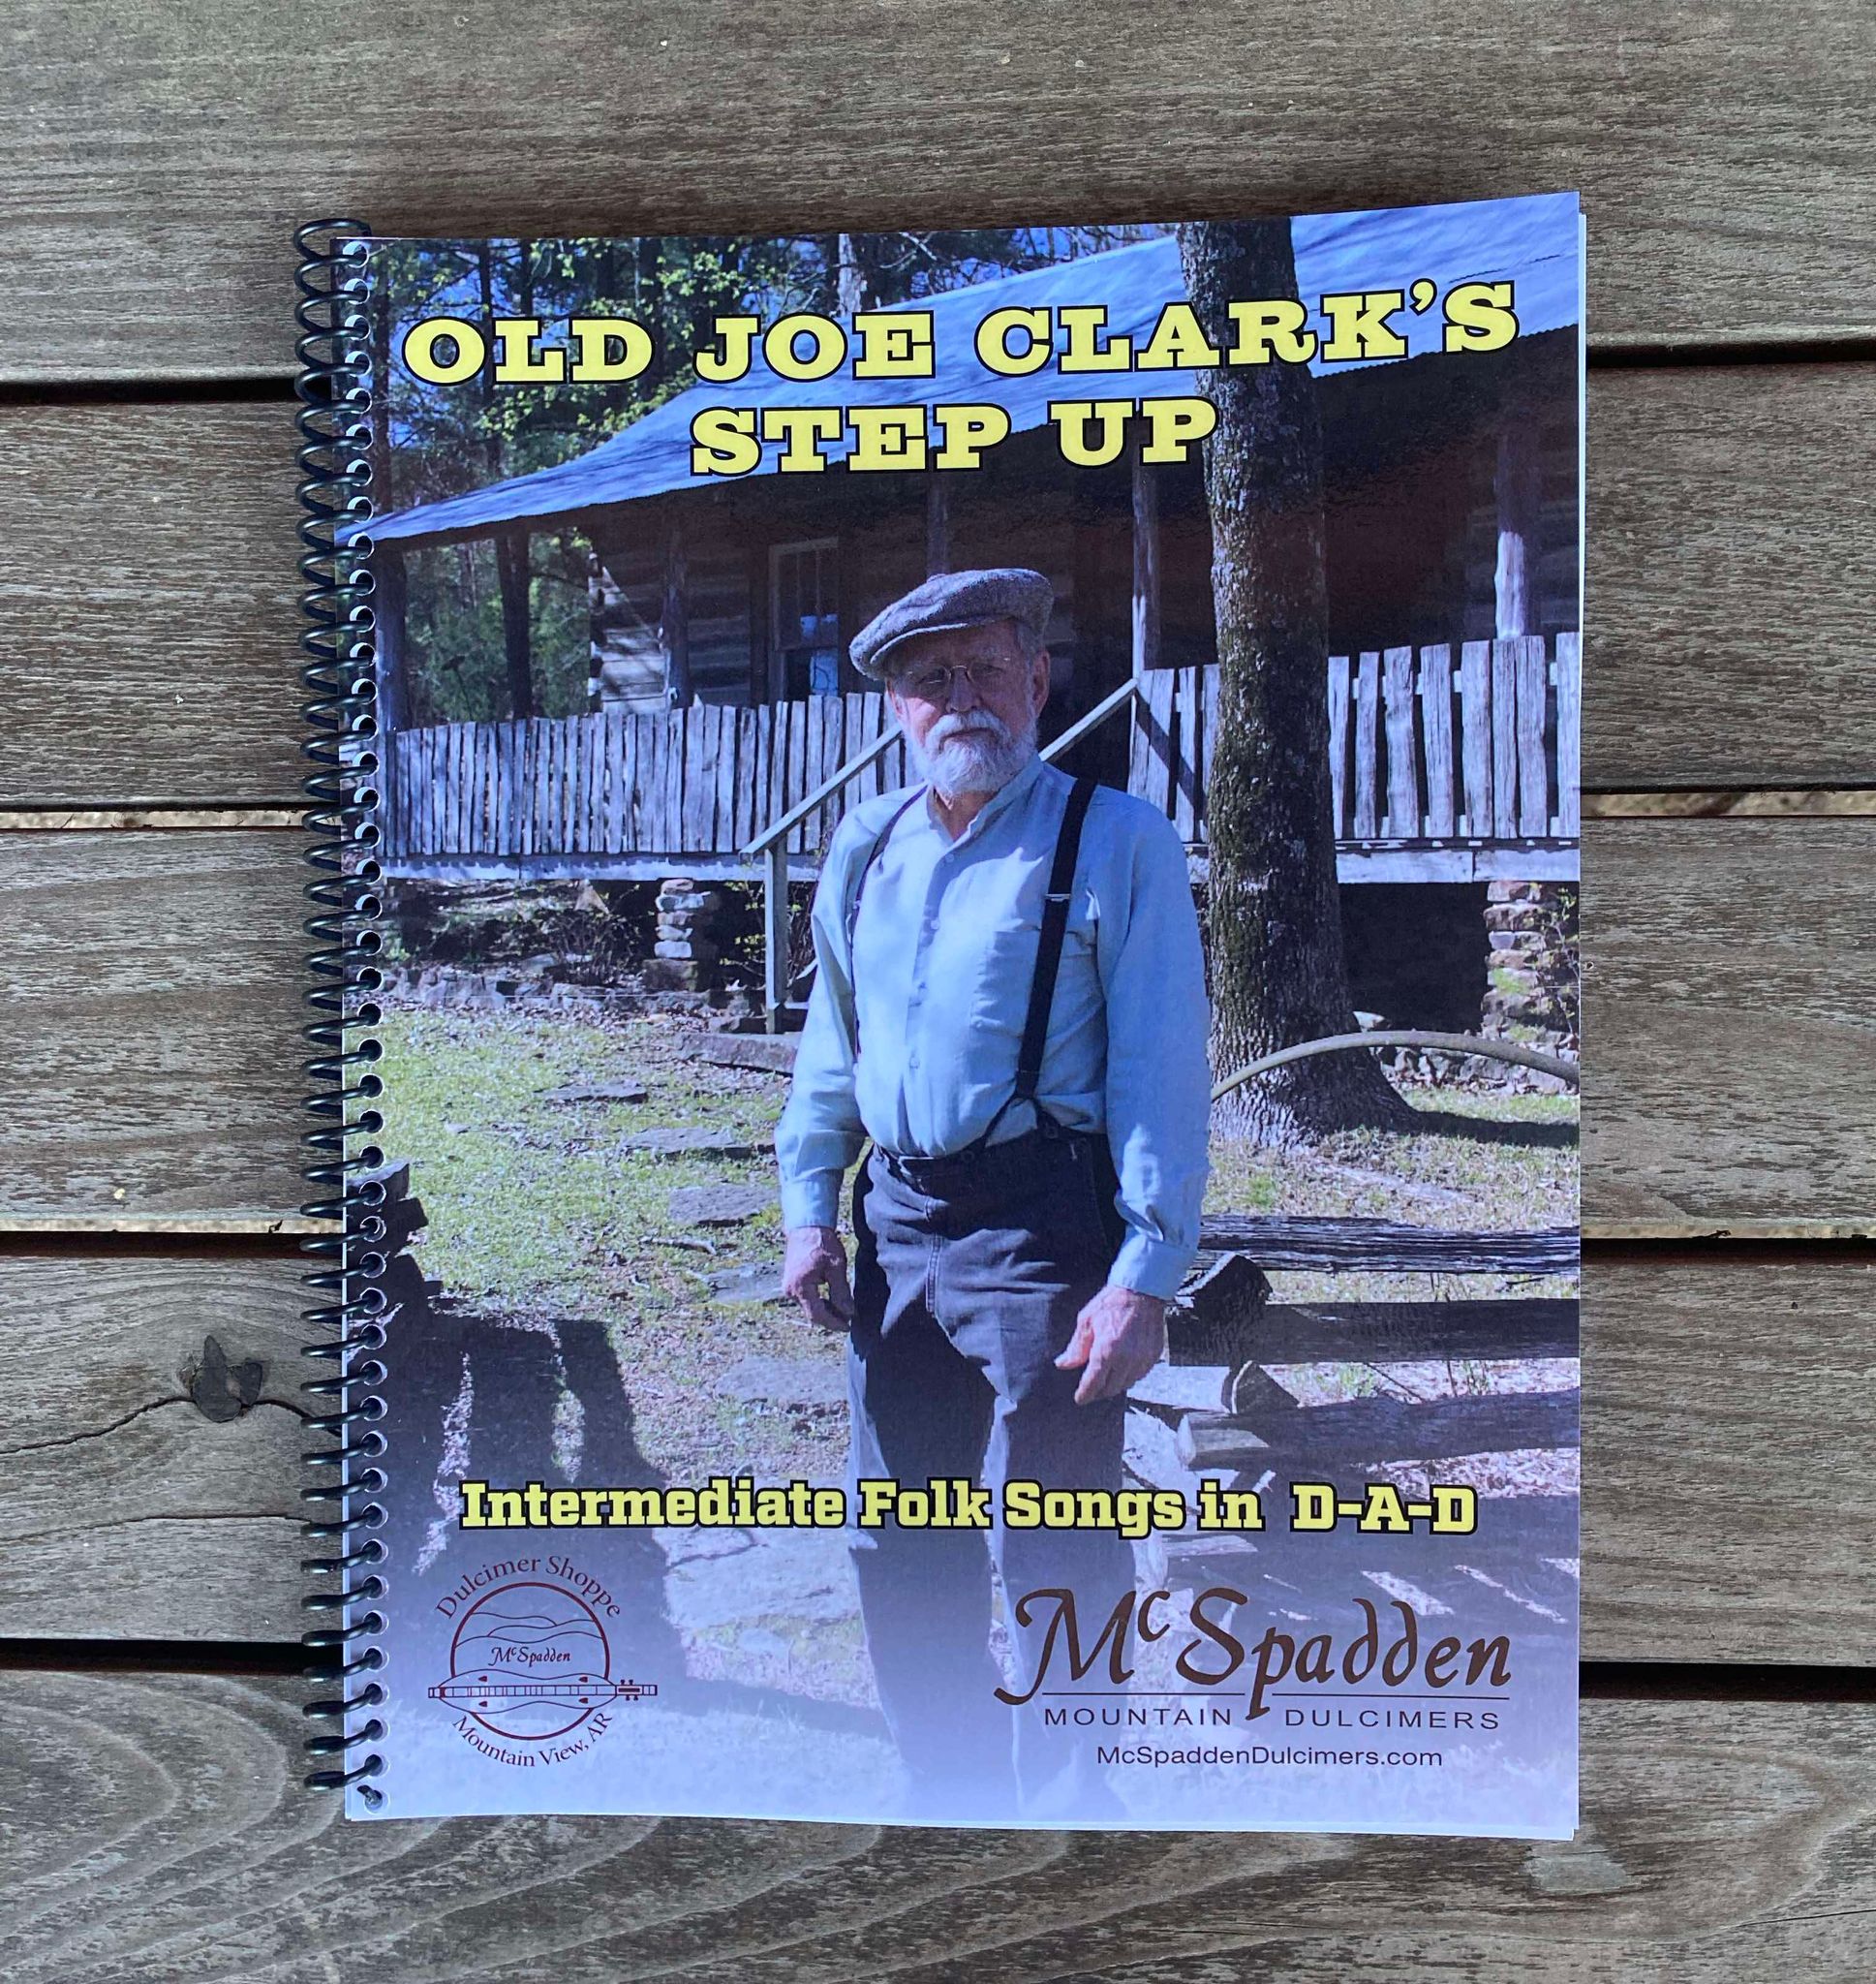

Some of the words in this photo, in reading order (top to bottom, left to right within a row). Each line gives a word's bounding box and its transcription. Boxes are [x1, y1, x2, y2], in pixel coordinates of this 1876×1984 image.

[402, 314, 655, 387] OLD
[692, 310, 936, 384] JOE
[974, 278, 1520, 378] CLARK’S
[690, 403, 1012, 477] STEP
[1047, 395, 1218, 470] UP
[459, 1477, 846, 1530] Intermediate
[857, 1477, 993, 1529] Folk
[1002, 1479, 1186, 1539] Songs
[1196, 1478, 1265, 1532] in
[1290, 1481, 1479, 1535] D-A-D
[436, 1558, 540, 1619] Dulcimer
[545, 1555, 620, 1618] Shoppe
[488, 1647, 570, 1667] McSpadden
[994, 1588, 1512, 1721] McSpadden
[452, 1716, 536, 1766] Mountain
[538, 1739, 589, 1766] View,
[587, 1712, 612, 1742] AR
[1044, 1708, 1232, 1726] MOUNTAIN
[1284, 1709, 1500, 1729] DULCIMERS
[1097, 1746, 1443, 1768] McSpaddenDulcimers.com
